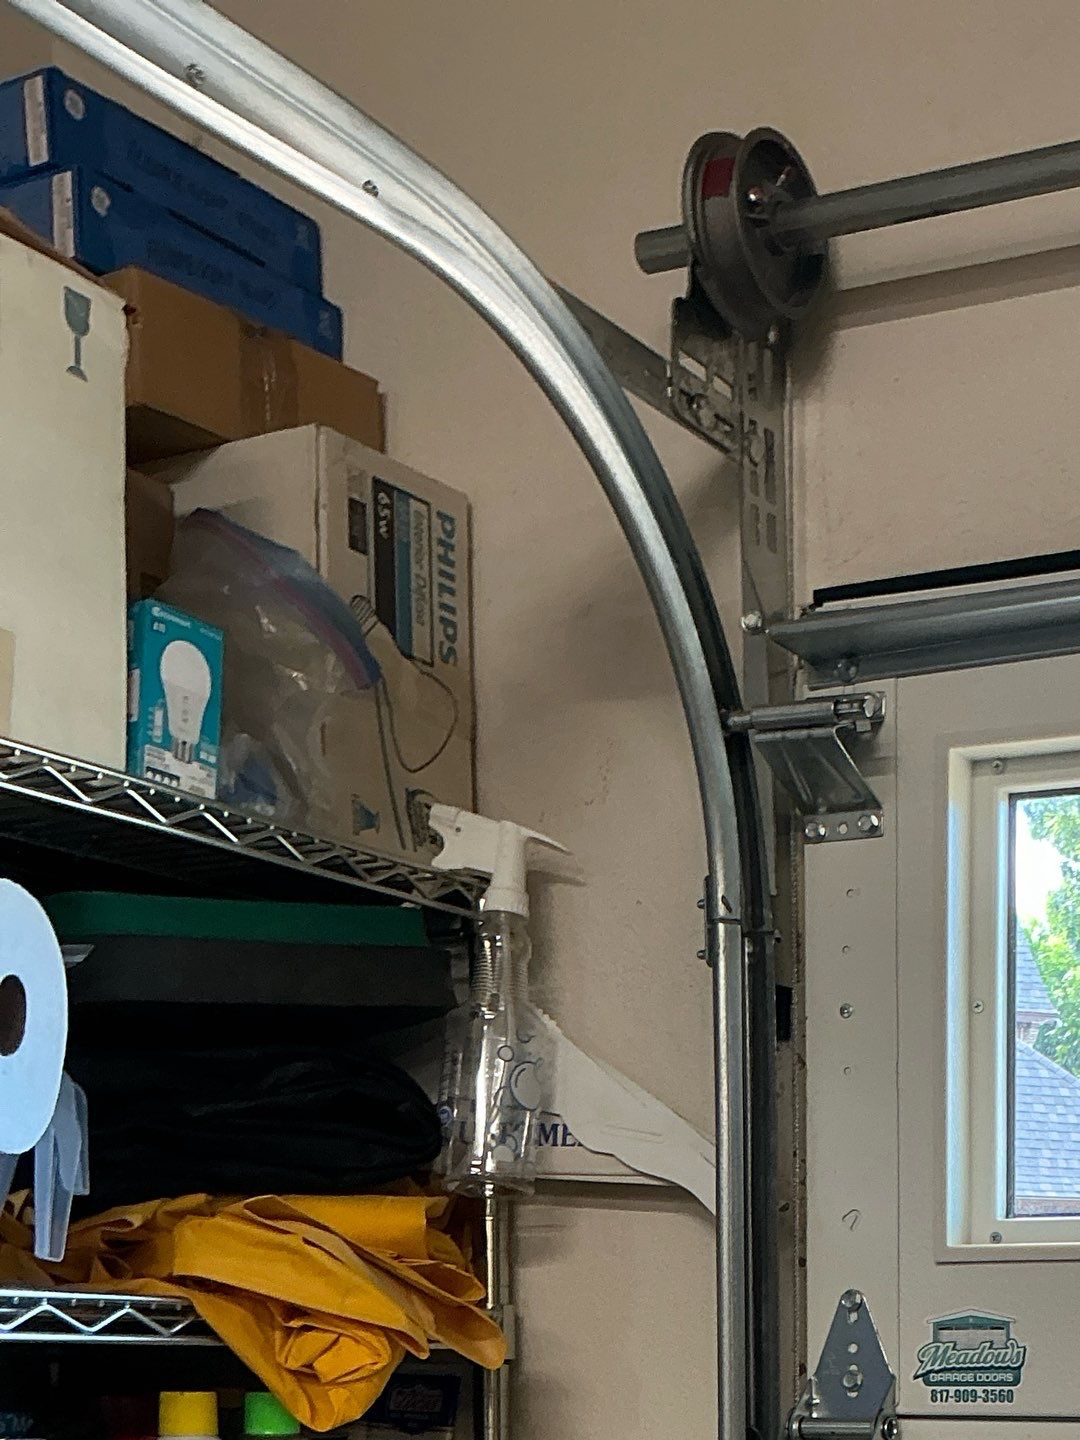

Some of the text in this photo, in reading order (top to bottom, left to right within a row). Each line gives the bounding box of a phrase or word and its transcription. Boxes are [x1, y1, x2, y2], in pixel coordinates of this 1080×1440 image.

[436, 509, 458, 667] PHILIPS
[538, 1123, 584, 1147] ME
[929, 1373, 1014, 1382] GARAGE DOORS
[930, 1388, 1014, 1403] 817-909-3560
